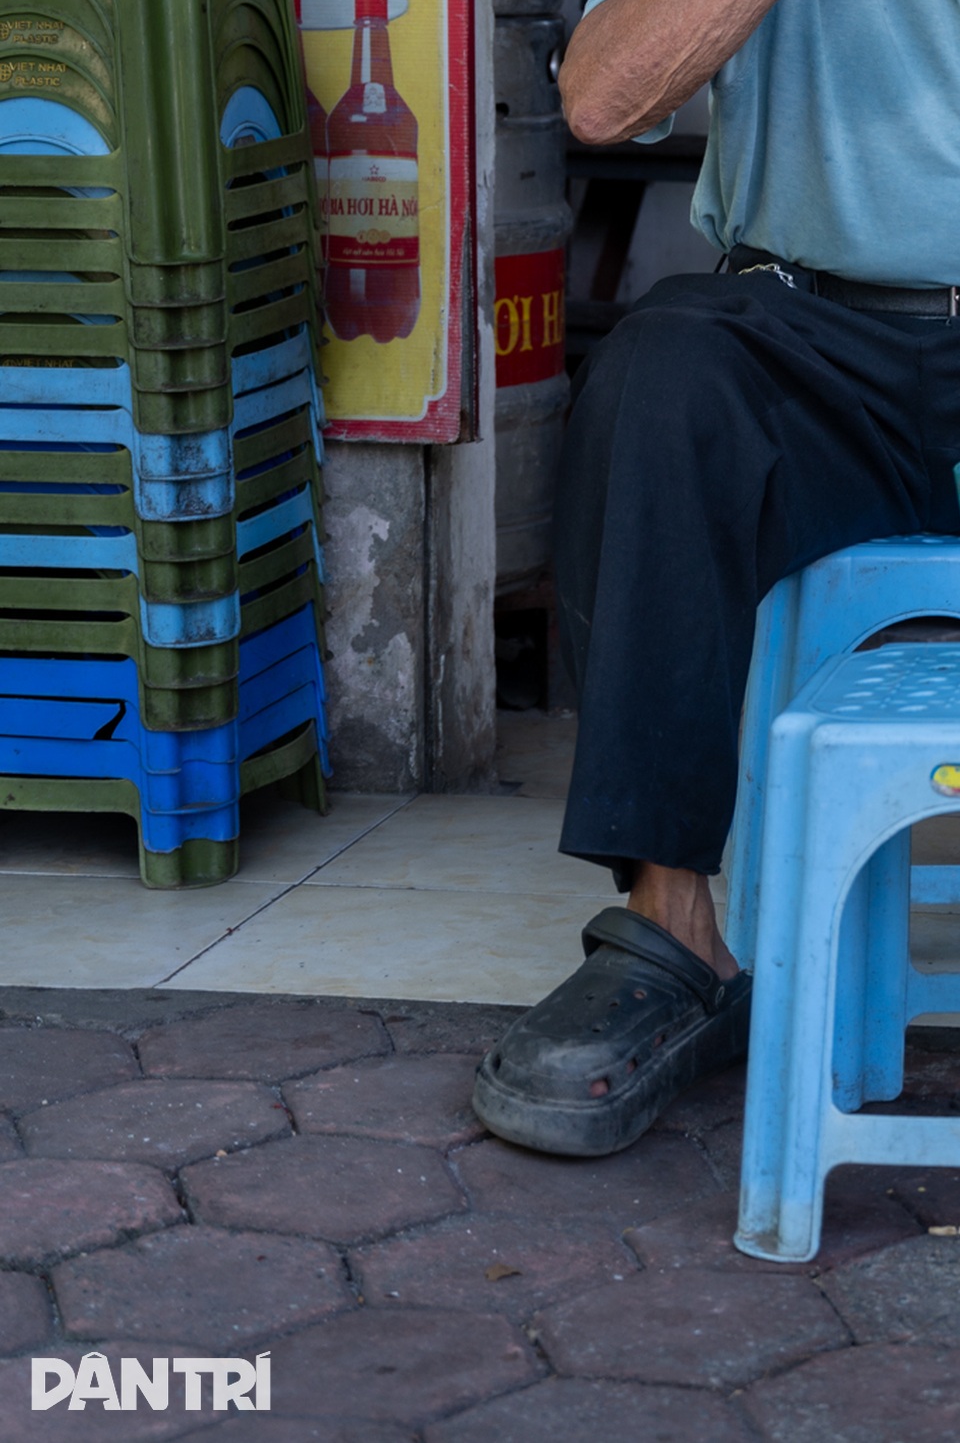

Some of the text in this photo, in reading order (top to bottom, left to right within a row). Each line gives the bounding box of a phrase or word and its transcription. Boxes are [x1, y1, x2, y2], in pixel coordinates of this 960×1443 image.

[15, 76, 61, 87] PLASTIC
[347, 198, 374, 215] HƠI
[378, 194, 398, 215] HÀ
